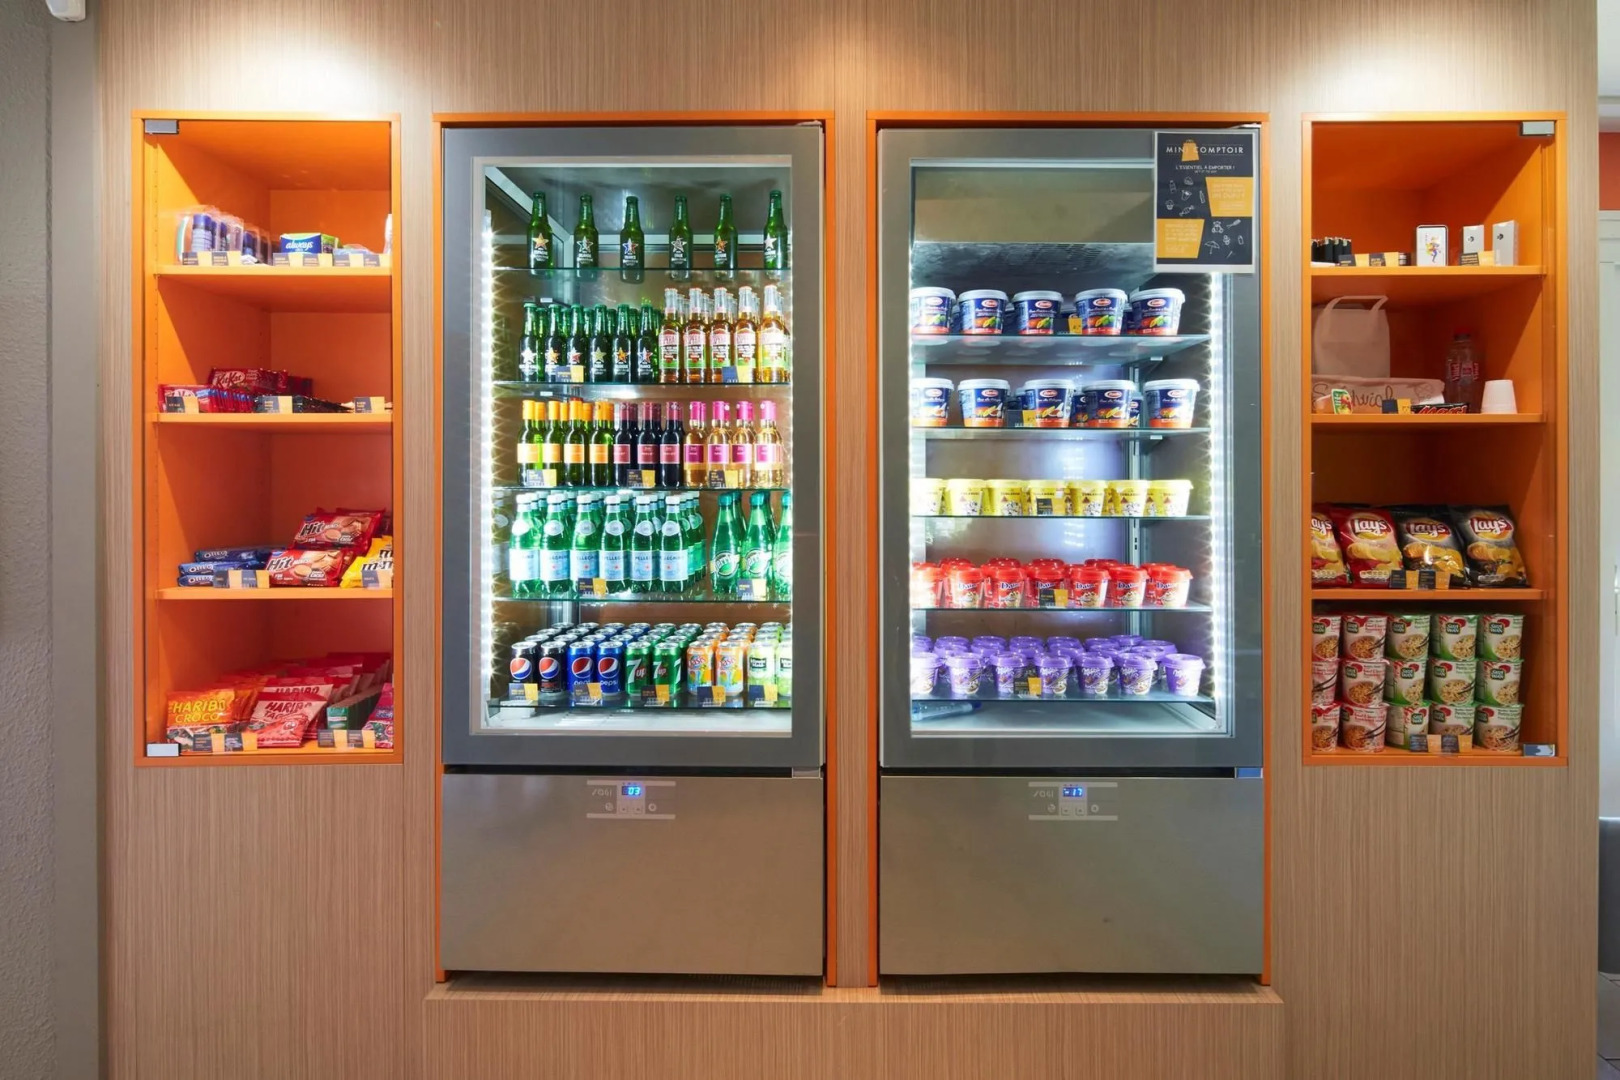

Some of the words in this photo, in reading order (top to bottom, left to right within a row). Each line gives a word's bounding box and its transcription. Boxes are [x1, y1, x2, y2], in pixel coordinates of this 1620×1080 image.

[1195, 146, 1244, 154] COMPTOIR
[286, 240, 313, 251] always
[217, 371, 242, 388] KitKat
[301, 521, 324, 536] Hit
[1354, 519, 1387, 535] Lay's
[1410, 523, 1446, 537] Lay's
[1473, 518, 1507, 535] Lay's
[267, 556, 293, 571] Hit
[172, 700, 226, 713] HARIBO
[175, 711, 219, 723] CROCO
[628, 787, 640, 795] 03
